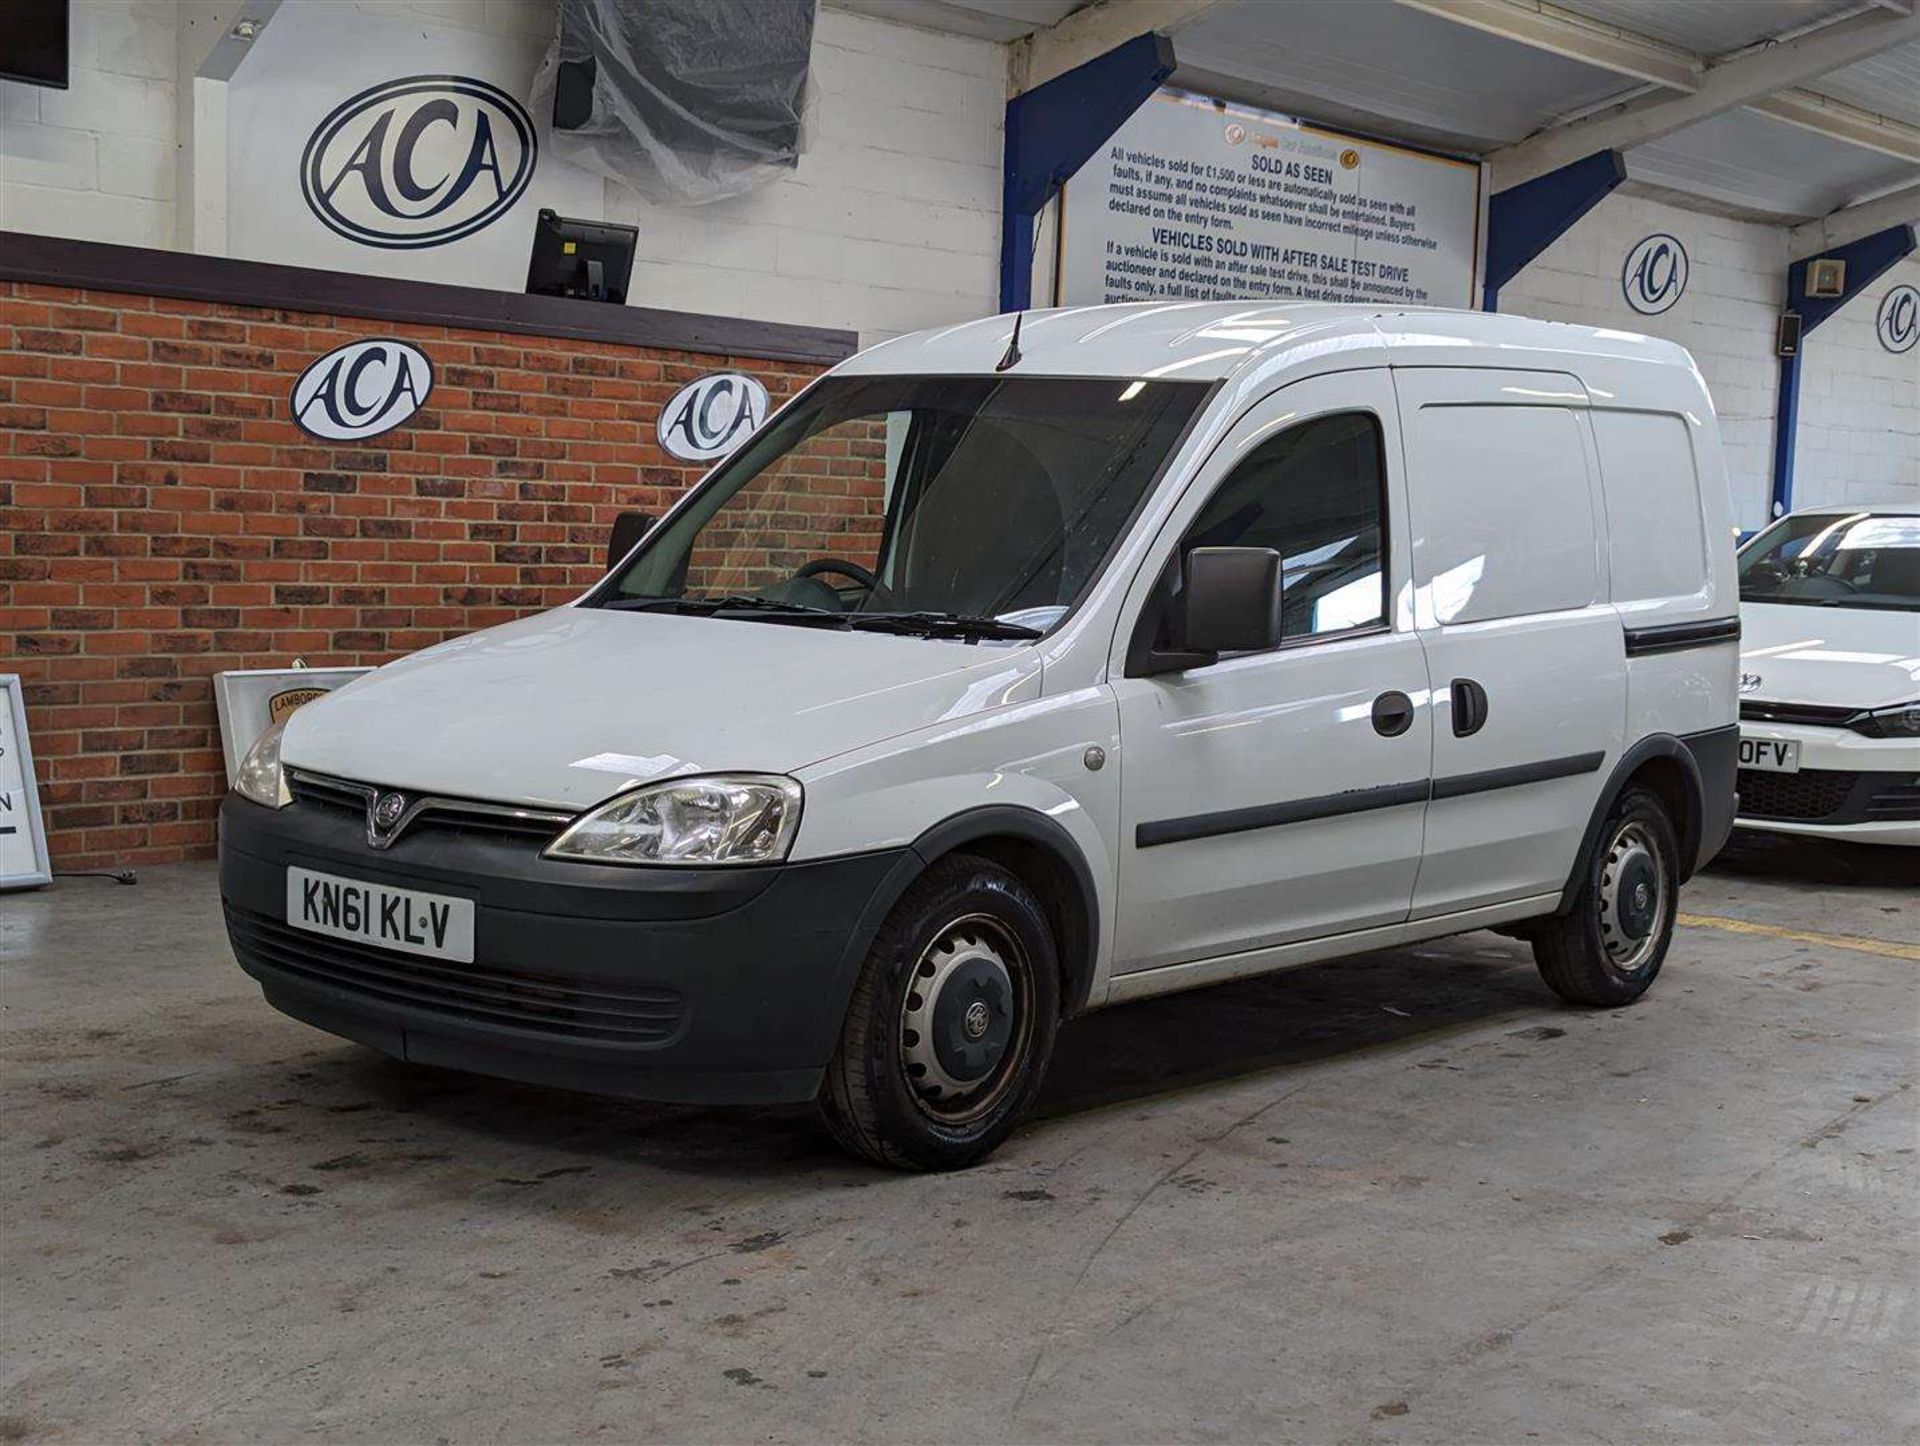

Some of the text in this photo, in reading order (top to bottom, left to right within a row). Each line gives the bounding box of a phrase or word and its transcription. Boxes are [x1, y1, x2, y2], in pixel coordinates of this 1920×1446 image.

[325, 99, 507, 219] ACA
[1111, 147, 1415, 217] All vehicles sold for £1,500 or less are automatically sold as seen with all
[1252, 154, 1332, 184] SOLD AS SEEN
[1109, 198, 1234, 230] declared on the entry form.
[1110, 183, 1437, 250] must assume all vehicles sold as seen have incorrect mileage unless otherwise
[1114, 165, 1415, 232] faults, if any, and no complaints whatsoever shall be entertained. Buyers
[1106, 260, 1156, 276] auctioneer
[1159, 268, 1176, 279] and
[1178, 269, 1218, 285] declared
[1220, 276, 1231, 286] on
[1234, 277, 1247, 289] the
[1249, 280, 1270, 294] entry
[1273, 281, 1294, 295] form.
[1296, 286, 1302, 296] A
[1304, 288, 1320, 299] test
[1322, 290, 1342, 302] drive
[1107, 241, 1427, 300] If a vehicle is sold with an after sale test drive, this shall be announced by the
[1153, 227, 1409, 282] VEHICLES SOLD WITH AFTER SALE TEST DRIVE
[1628, 243, 1678, 304] ACA
[1106, 275, 1132, 290] faults
[1135, 280, 1156, 295] only,
[1159, 284, 1165, 294] a
[1167, 285, 1181, 297] full
[1184, 286, 1198, 299] list
[1201, 290, 1210, 299] of
[299, 348, 420, 428] ACA
[664, 379, 756, 450] ACA
[304, 878, 449, 948] KN61 KLV
